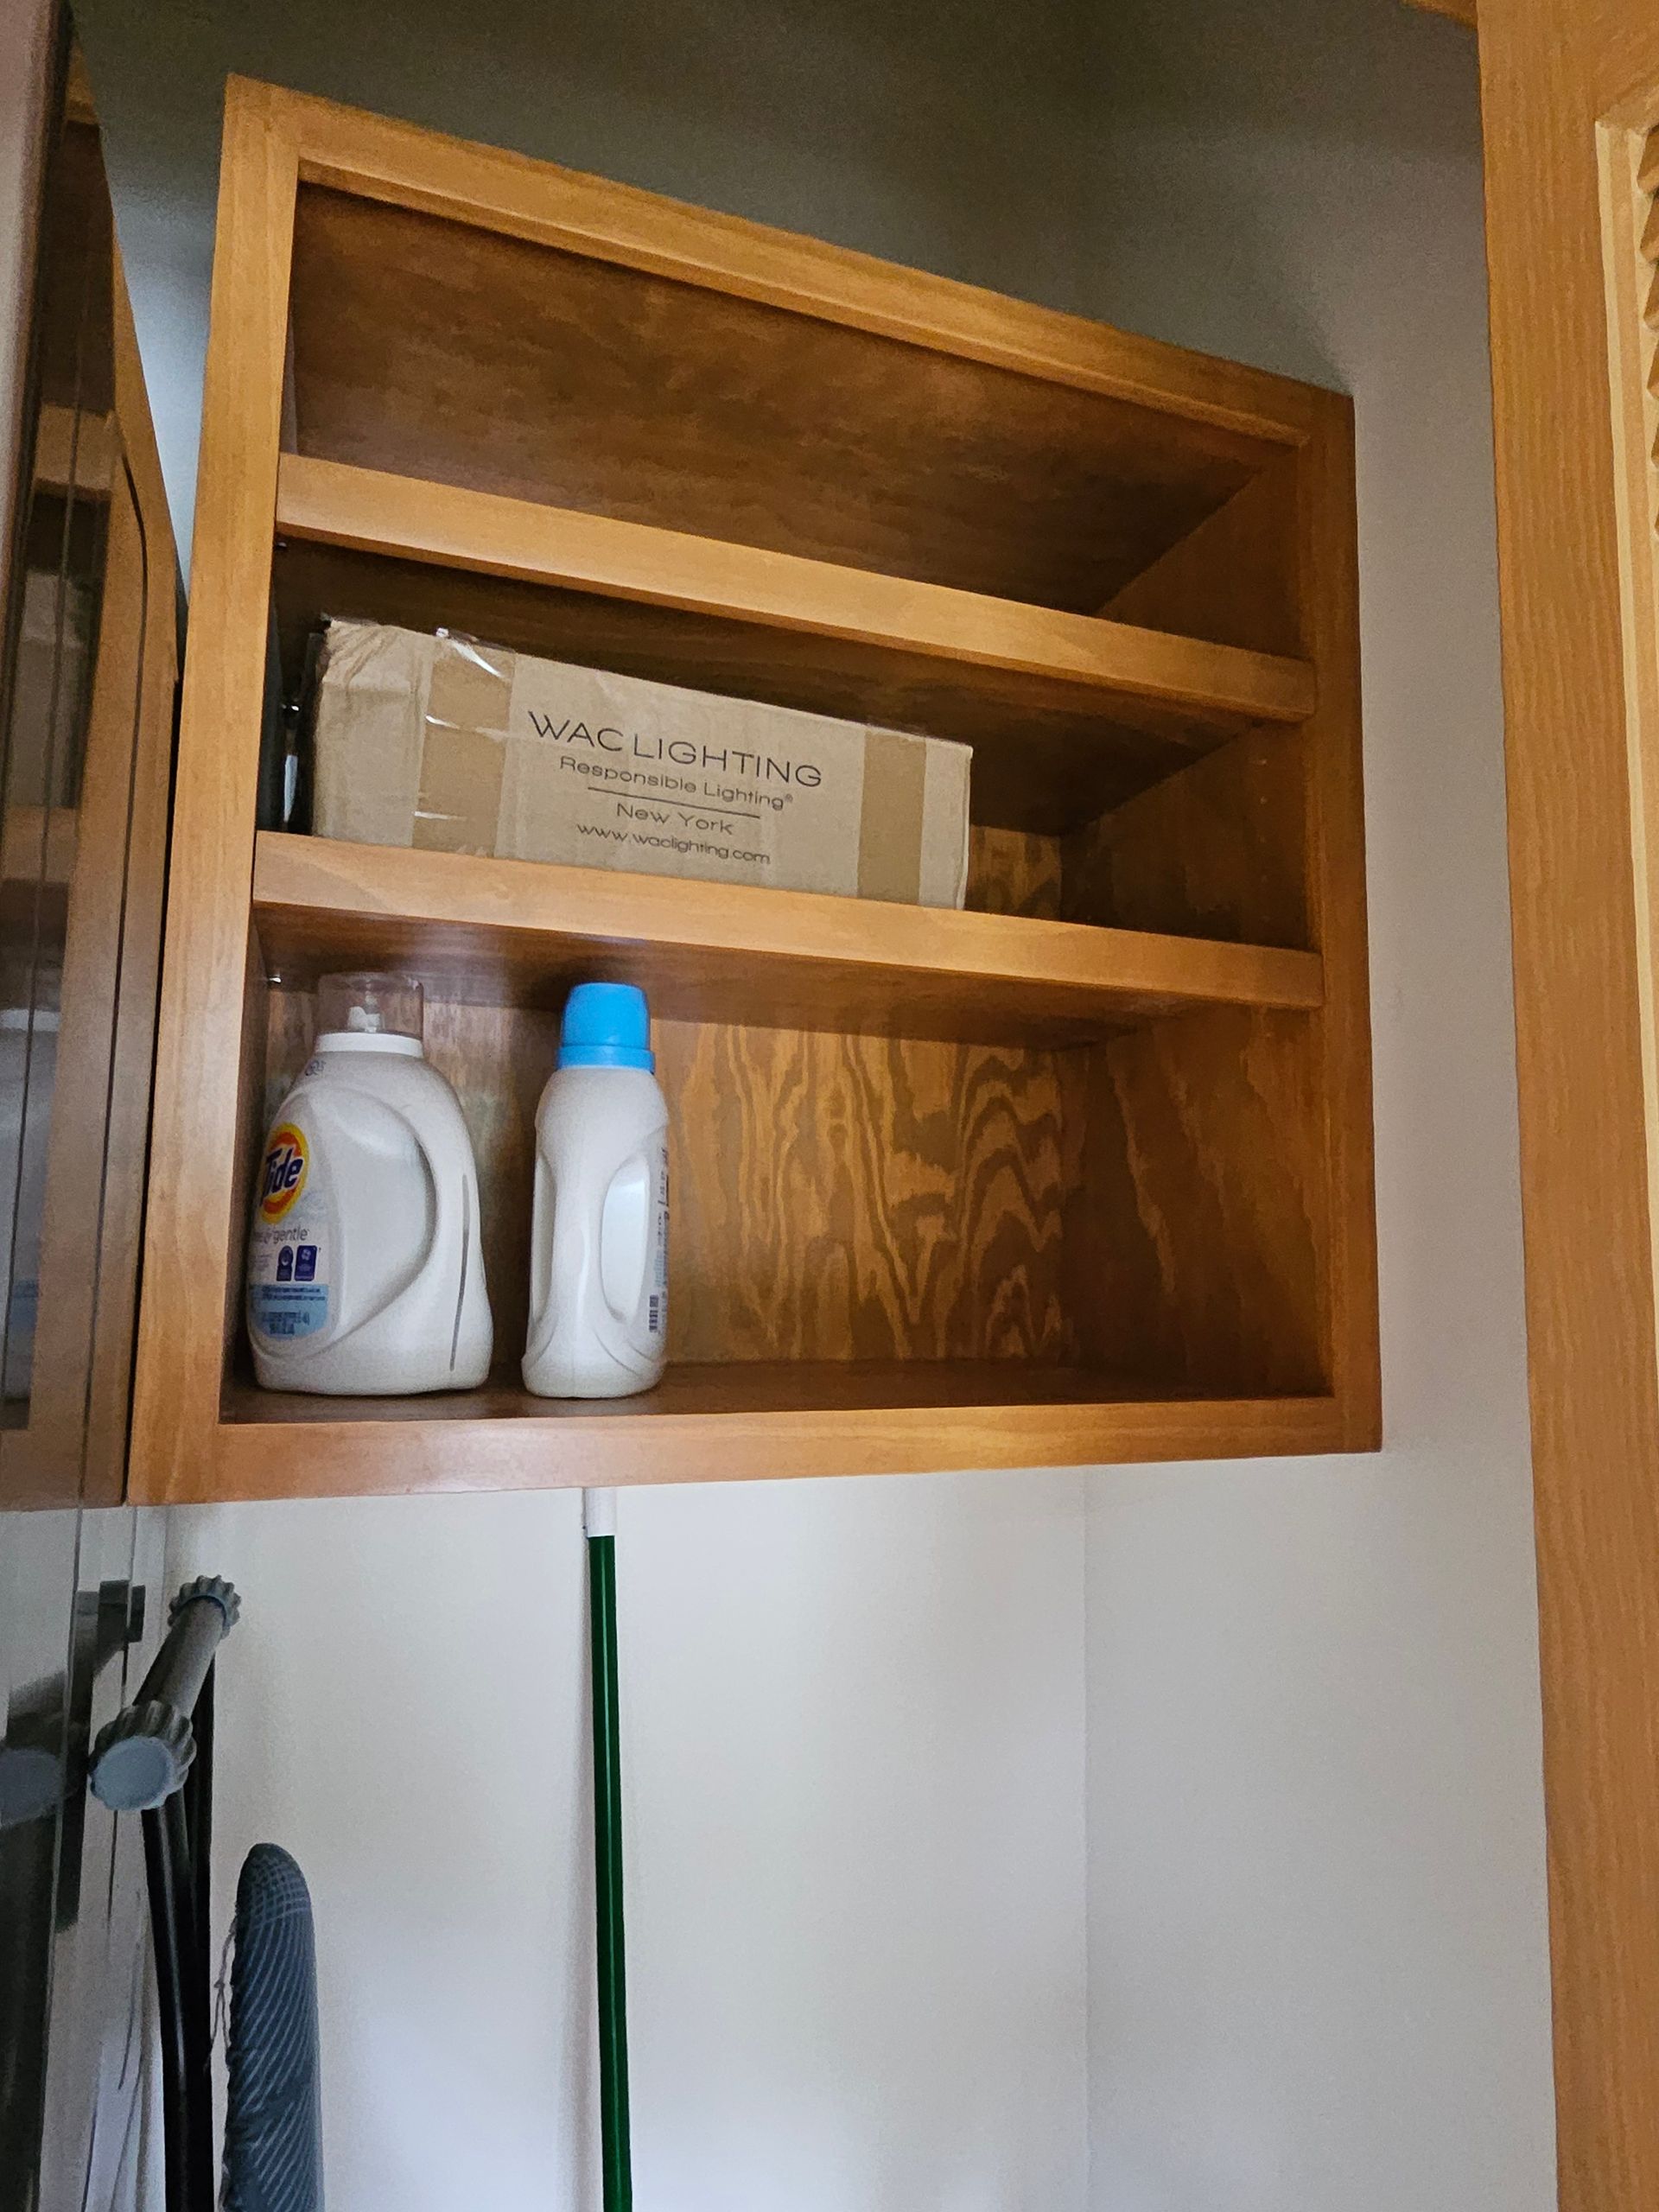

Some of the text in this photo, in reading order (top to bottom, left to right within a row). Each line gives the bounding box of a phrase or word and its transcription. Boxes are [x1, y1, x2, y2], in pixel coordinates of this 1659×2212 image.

[560, 755, 696, 794] Responsible
[632, 733, 823, 788] LIGHTING
[616, 803, 734, 836] New York
[577, 823, 771, 865] www.waclighting.com
[260, 1147, 304, 1205] Tide
